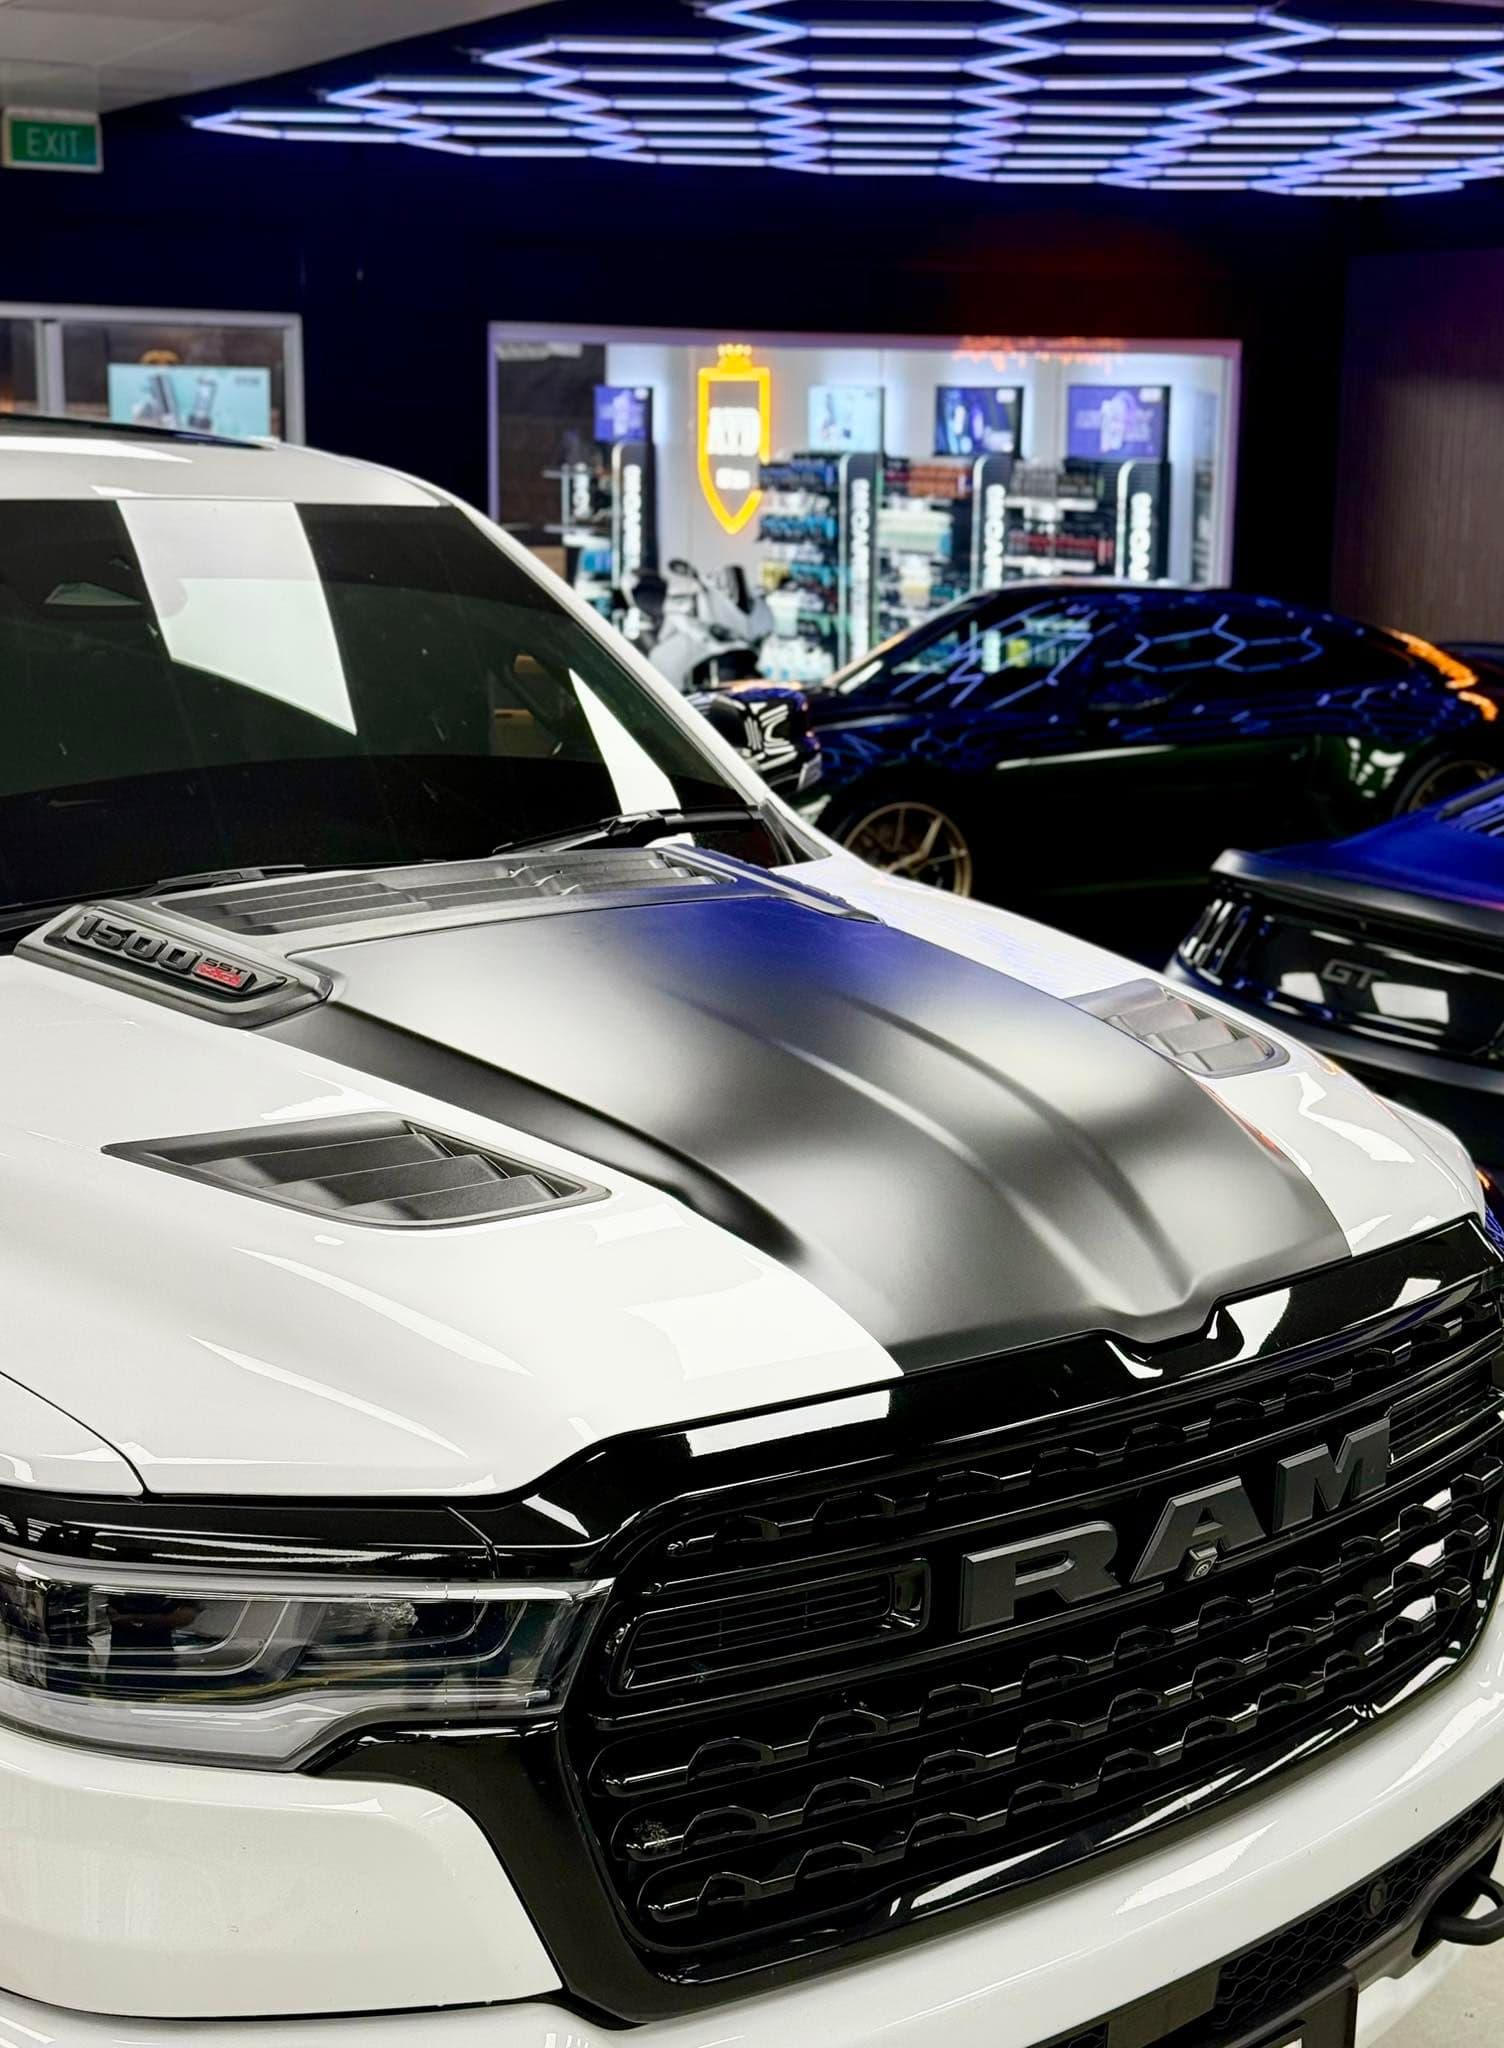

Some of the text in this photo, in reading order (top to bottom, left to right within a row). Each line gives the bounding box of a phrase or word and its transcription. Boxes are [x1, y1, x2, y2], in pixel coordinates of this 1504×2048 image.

[26, 127, 79, 158] EXIT
[77, 915, 202, 975] 1500
[202, 957, 248, 976] SST
[1321, 958, 1386, 989] GT
[961, 1419, 1391, 1634] RAM
